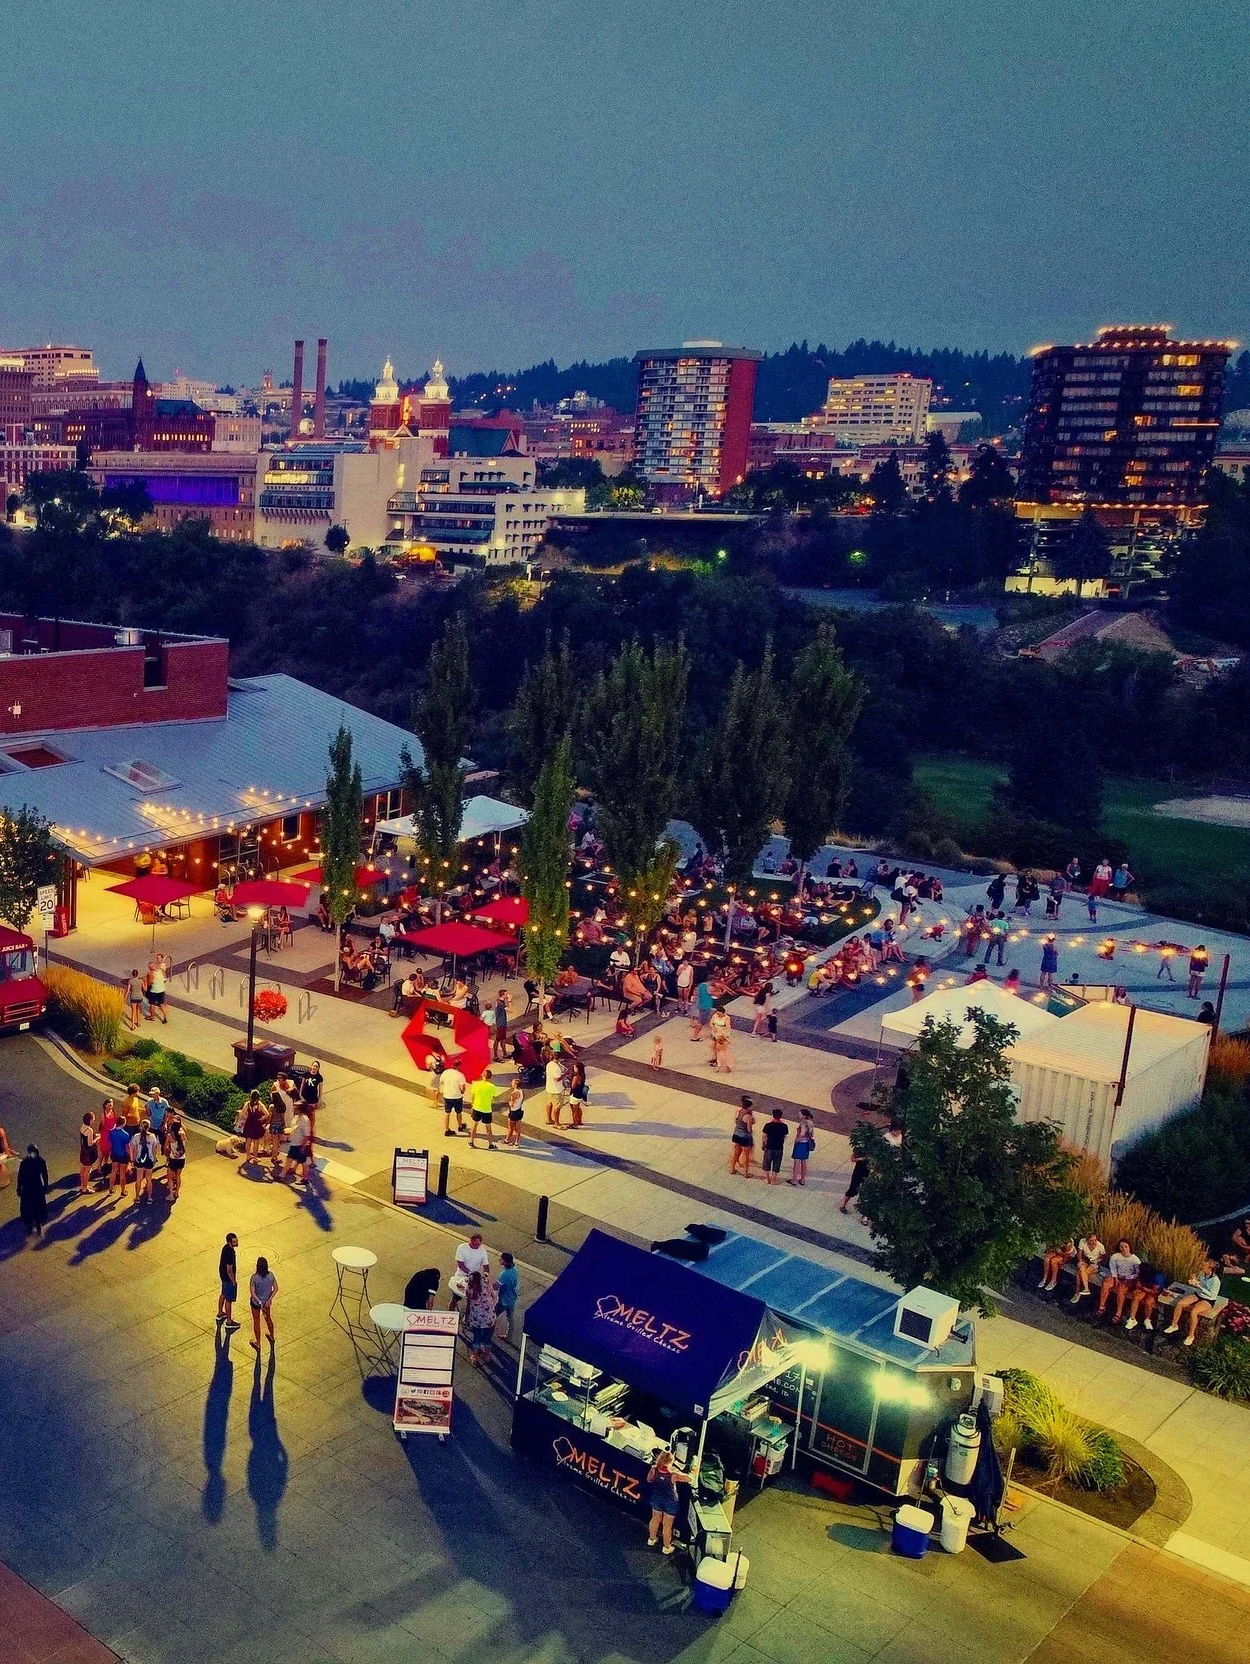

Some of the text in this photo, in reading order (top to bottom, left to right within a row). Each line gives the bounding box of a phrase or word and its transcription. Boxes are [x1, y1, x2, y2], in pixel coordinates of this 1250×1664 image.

[40, 900, 53, 911] 20
[416, 1315, 456, 1326] MELTZ
[613, 1303, 691, 1350] MELTZ
[570, 1447, 641, 1500] MELTZ
